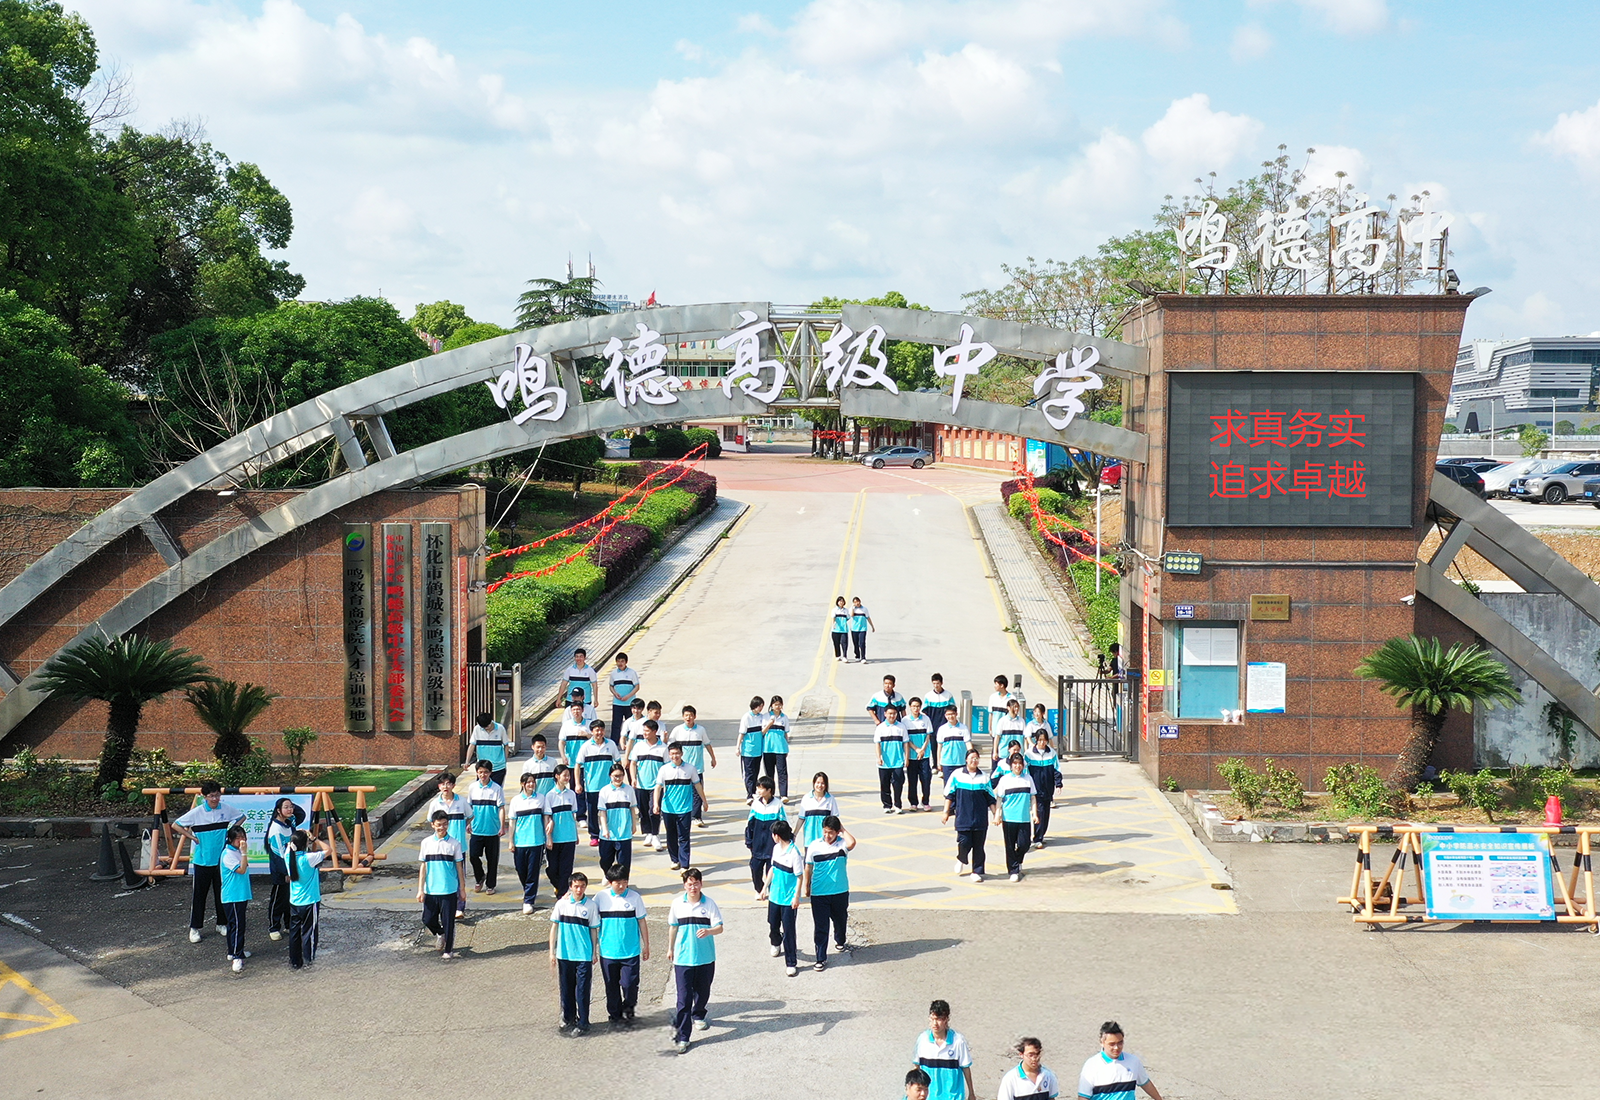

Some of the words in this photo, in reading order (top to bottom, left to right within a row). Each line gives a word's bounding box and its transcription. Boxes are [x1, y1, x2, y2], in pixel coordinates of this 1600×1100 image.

[1173, 192, 1456, 275] 鸣德高中
[484, 310, 1104, 431] 鸣德高级中学
[1209, 409, 1367, 448] 求真务实
[1209, 460, 1367, 499] 追求卓越
[347, 558, 366, 721] 一鸣教育商学院人才培训基地
[425, 533, 444, 721] 怀化市鹤城区鸣德高级中学
